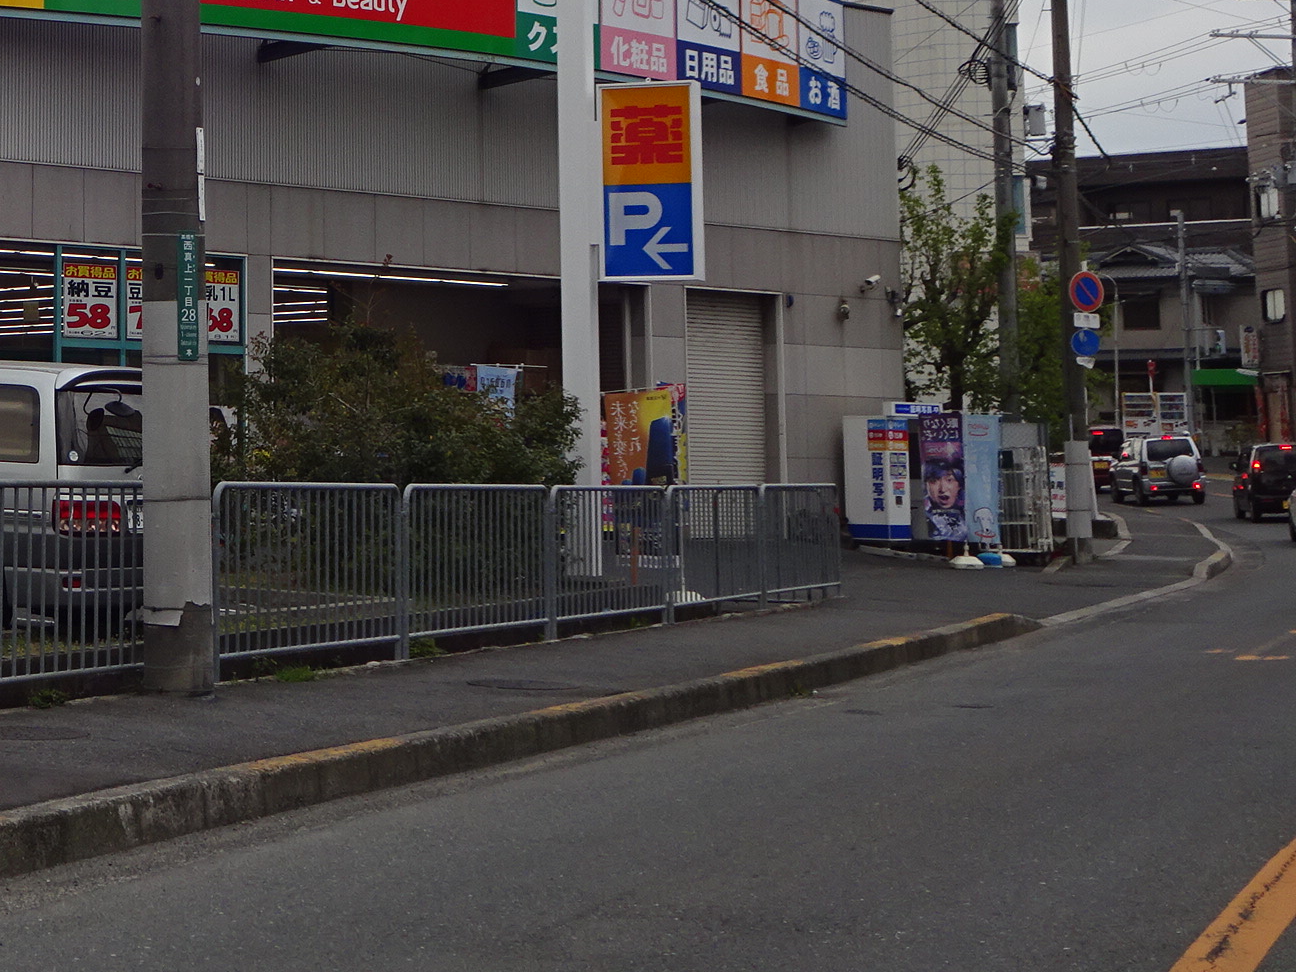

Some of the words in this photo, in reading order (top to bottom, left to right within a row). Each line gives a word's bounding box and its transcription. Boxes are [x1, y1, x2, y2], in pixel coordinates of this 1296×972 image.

[610, 36, 668, 74] 化粧品
[685, 48, 735, 86] 日用品
[754, 62, 790, 98] 食品
[808, 75, 841, 112] お酒
[610, 104, 683, 166] 薬
[609, 191, 663, 247] P
[65, 265, 116, 279] お買得品
[67, 280, 114, 299] 納豆
[127, 268, 142, 280] お
[183, 241, 193, 307] 西真上一丁目
[66, 303, 111, 330] 58
[181, 308, 196, 322] 28
